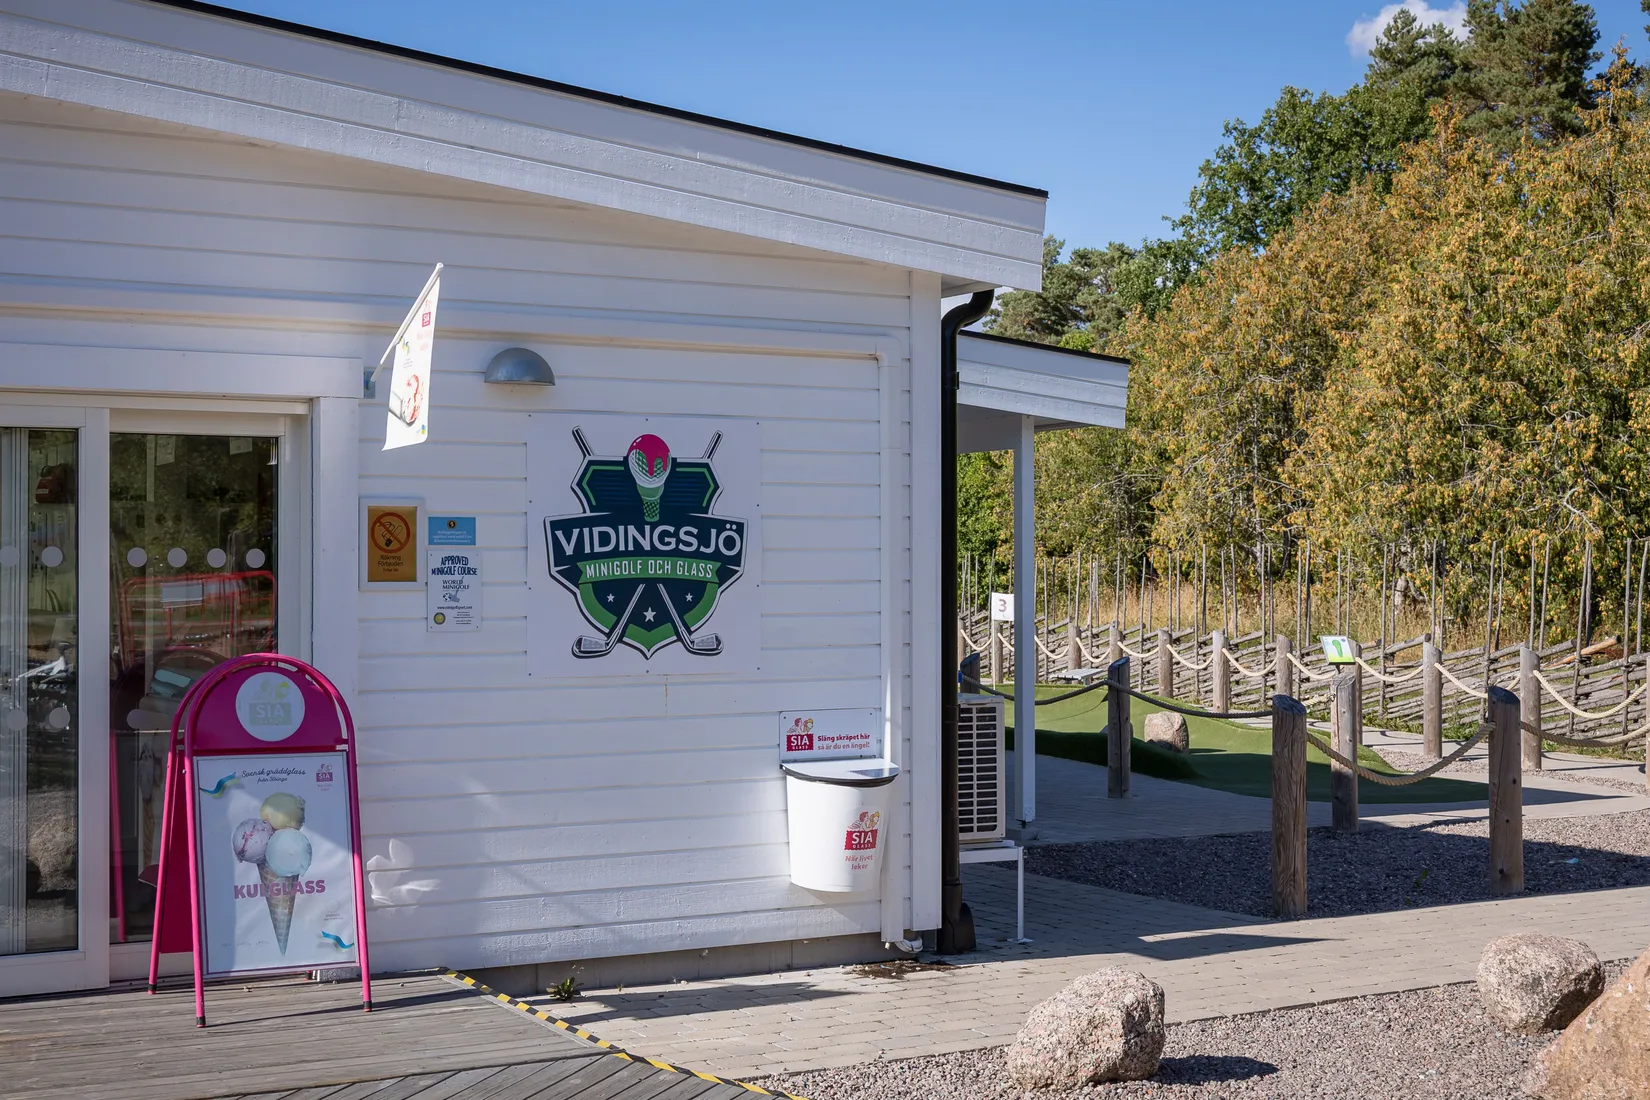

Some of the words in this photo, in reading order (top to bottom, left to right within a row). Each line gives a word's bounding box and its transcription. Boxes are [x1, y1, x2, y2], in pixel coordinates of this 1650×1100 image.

[554, 523, 742, 557] VIDINGSJÖ
[440, 555, 469, 566] APPROVED
[431, 565, 457, 576] MINIGOLF
[457, 566, 478, 576] COURSE
[585, 559, 643, 579] MINIGOLF
[648, 560, 672, 575] OCH
[676, 560, 713, 578] GLASS
[999, 598, 1007, 613] 3
[256, 704, 285, 718] SIA
[791, 736, 809, 746] SIA
[833, 742, 841, 750] du
[850, 741, 870, 750] ängel!
[241, 768, 265, 778] Svensk
[265, 767, 307, 777] gräddglass
[852, 832, 872, 844] SIA
[851, 863, 868, 871] leker
[233, 879, 326, 900] KULGLASS
